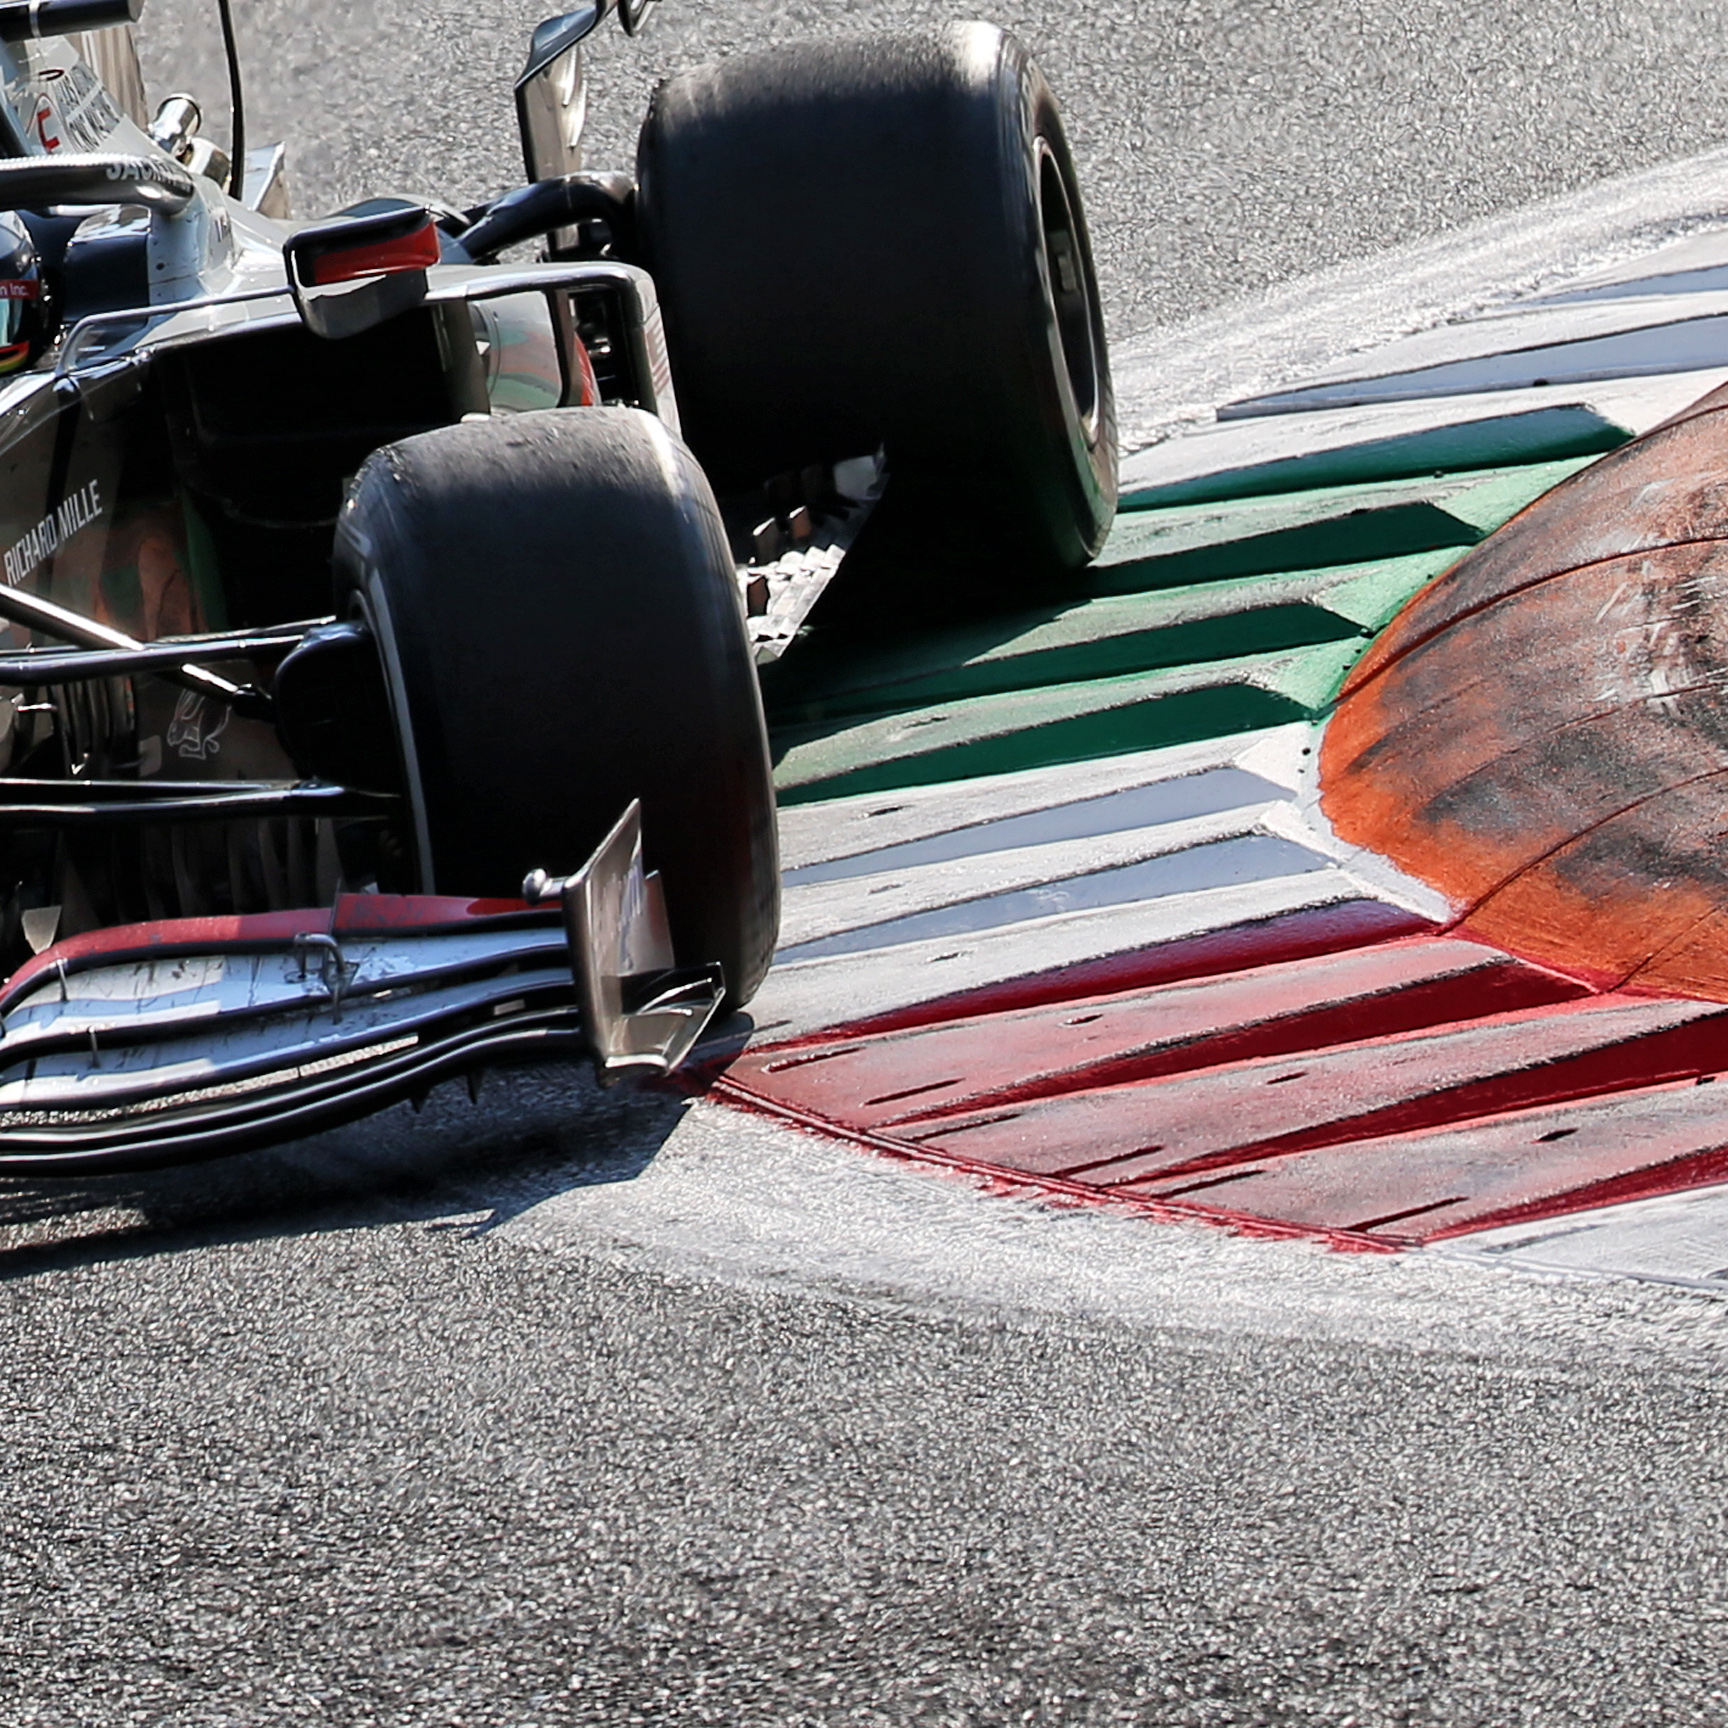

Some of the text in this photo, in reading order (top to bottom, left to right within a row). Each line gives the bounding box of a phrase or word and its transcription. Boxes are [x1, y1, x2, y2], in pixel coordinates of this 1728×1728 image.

[10, 281, 30, 297] Inc.
[3, 478, 103, 588] RICHARD MILLE
